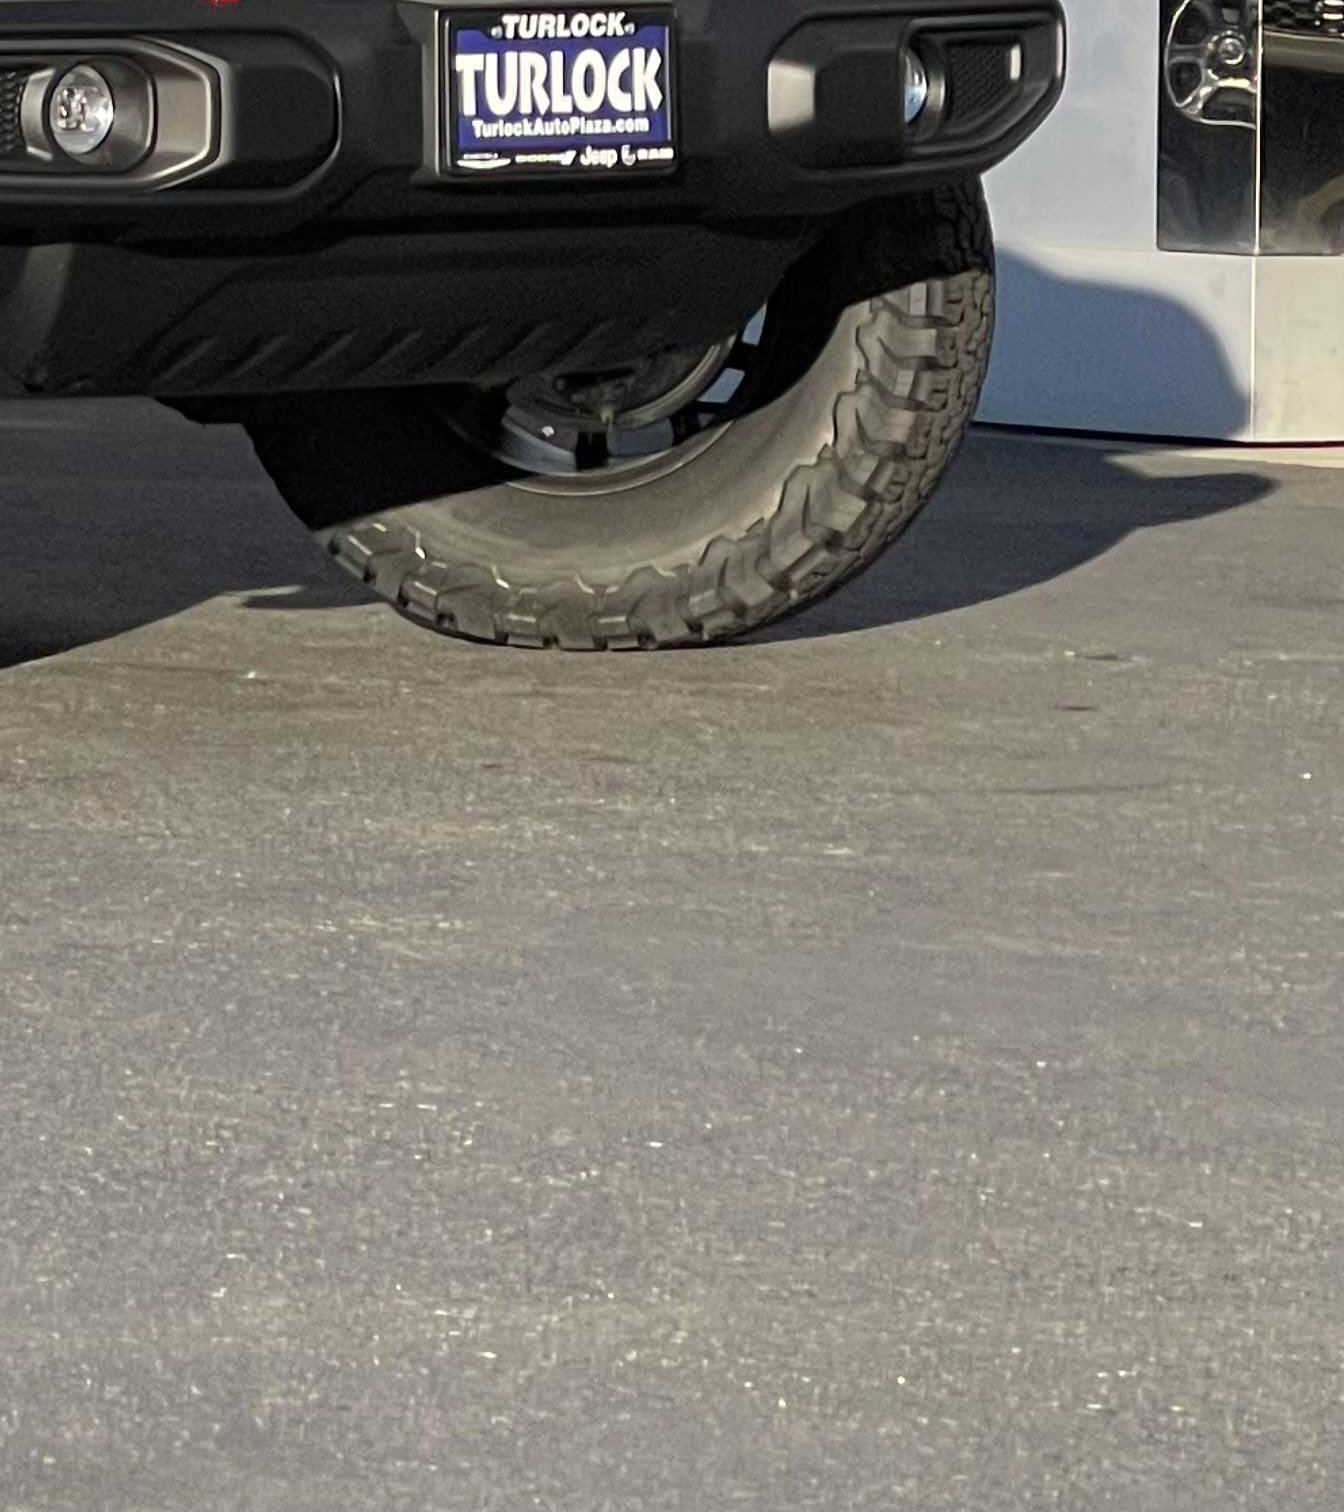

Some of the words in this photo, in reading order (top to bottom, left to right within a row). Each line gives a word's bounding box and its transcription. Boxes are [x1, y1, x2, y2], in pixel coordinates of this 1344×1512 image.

[502, 12, 626, 38] TURLOCK
[455, 47, 663, 117] TURLOCK
[472, 116, 650, 139] TurlockAutoPlaza.com
[580, 145, 618, 168] Jeep
